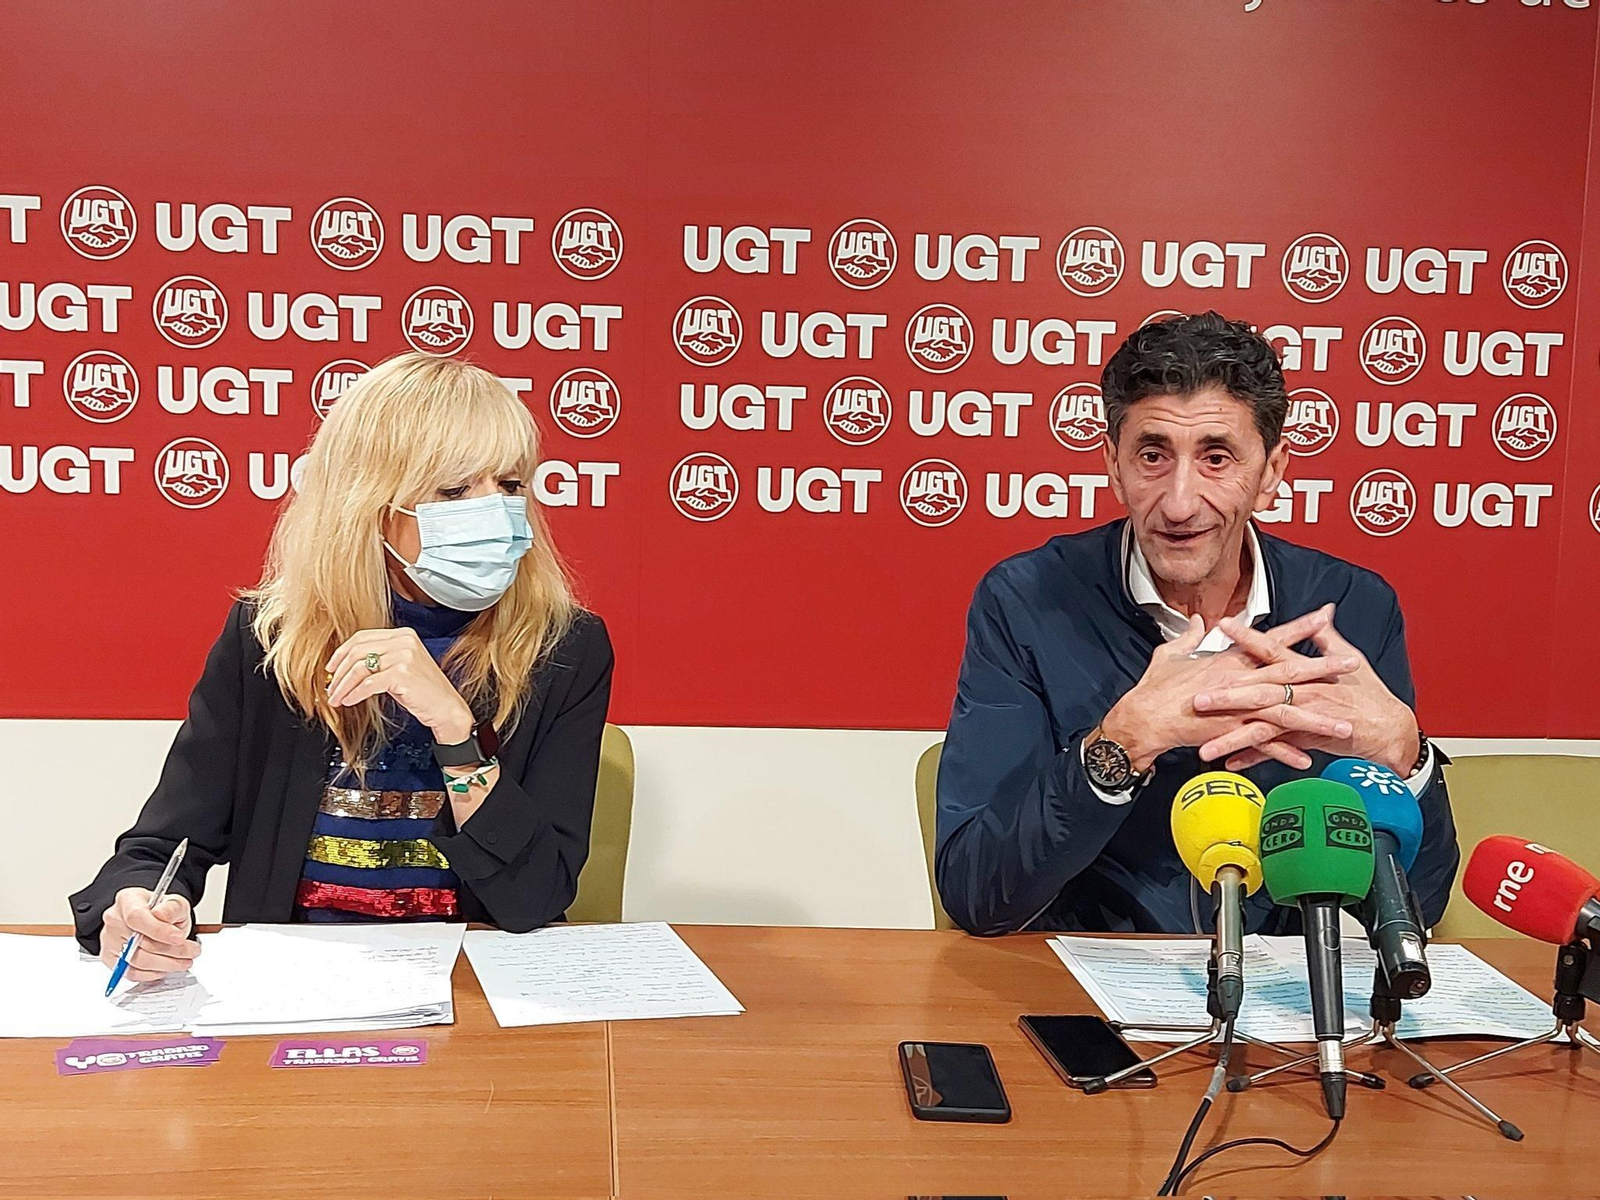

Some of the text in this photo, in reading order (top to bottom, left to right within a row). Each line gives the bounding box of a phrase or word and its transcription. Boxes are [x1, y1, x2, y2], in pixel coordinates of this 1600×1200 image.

[72, 199, 125, 226] UGT
[321, 211, 373, 237] UGT
[155, 203, 291, 254] UGT
[403, 214, 534, 264] UGT
[562, 221, 612, 248] UGT
[838, 231, 887, 257] UGT
[683, 225, 811, 275] UGT
[915, 234, 1040, 282] UGT
[1066, 239, 1114, 265] UGT
[1142, 241, 1266, 288] UGT
[1291, 246, 1339, 272] UGT
[1512, 252, 1558, 277] UGT
[1365, 248, 1488, 294] UGT
[0, 282, 132, 333] UGT
[164, 289, 217, 315] UGT
[248, 292, 381, 342] UGT
[412, 299, 462, 325] UGT
[493, 302, 622, 351] UGT
[683, 308, 732, 334] UGT
[761, 312, 888, 359] UGT
[915, 316, 963, 342] UGT
[992, 319, 1117, 366] UGT
[1250, 325, 1343, 371] GT
[1369, 329, 1416, 354] UGT
[1443, 331, 1563, 377] UGT
[74, 364, 128, 390] UGT
[158, 366, 293, 416] UGT
[560, 380, 610, 406] UGT
[680, 384, 806, 431] UGT
[833, 389, 881, 414] UGT
[909, 390, 1032, 437] UGT
[1355, 402, 1476, 447] UGT
[1501, 406, 1547, 430] UGT
[0, 445, 134, 494] UGT
[165, 450, 218, 476] UGT
[680, 465, 728, 490] UGT
[532, 460, 620, 507] GT
[757, 467, 881, 513] UGT
[909, 471, 957, 496] UGT
[986, 473, 1109, 519] UGT
[1359, 481, 1406, 506] UGT
[1252, 480, 1334, 523] GT
[1434, 483, 1552, 528] UGT
[1182, 780, 1262, 811] SER
[1265, 816, 1297, 831] ONDA
[1336, 831, 1368, 846] CERO
[1265, 832, 1297, 848] CERO
[1493, 861, 1535, 913] rne
[285, 1046, 381, 1059] ELLAS
